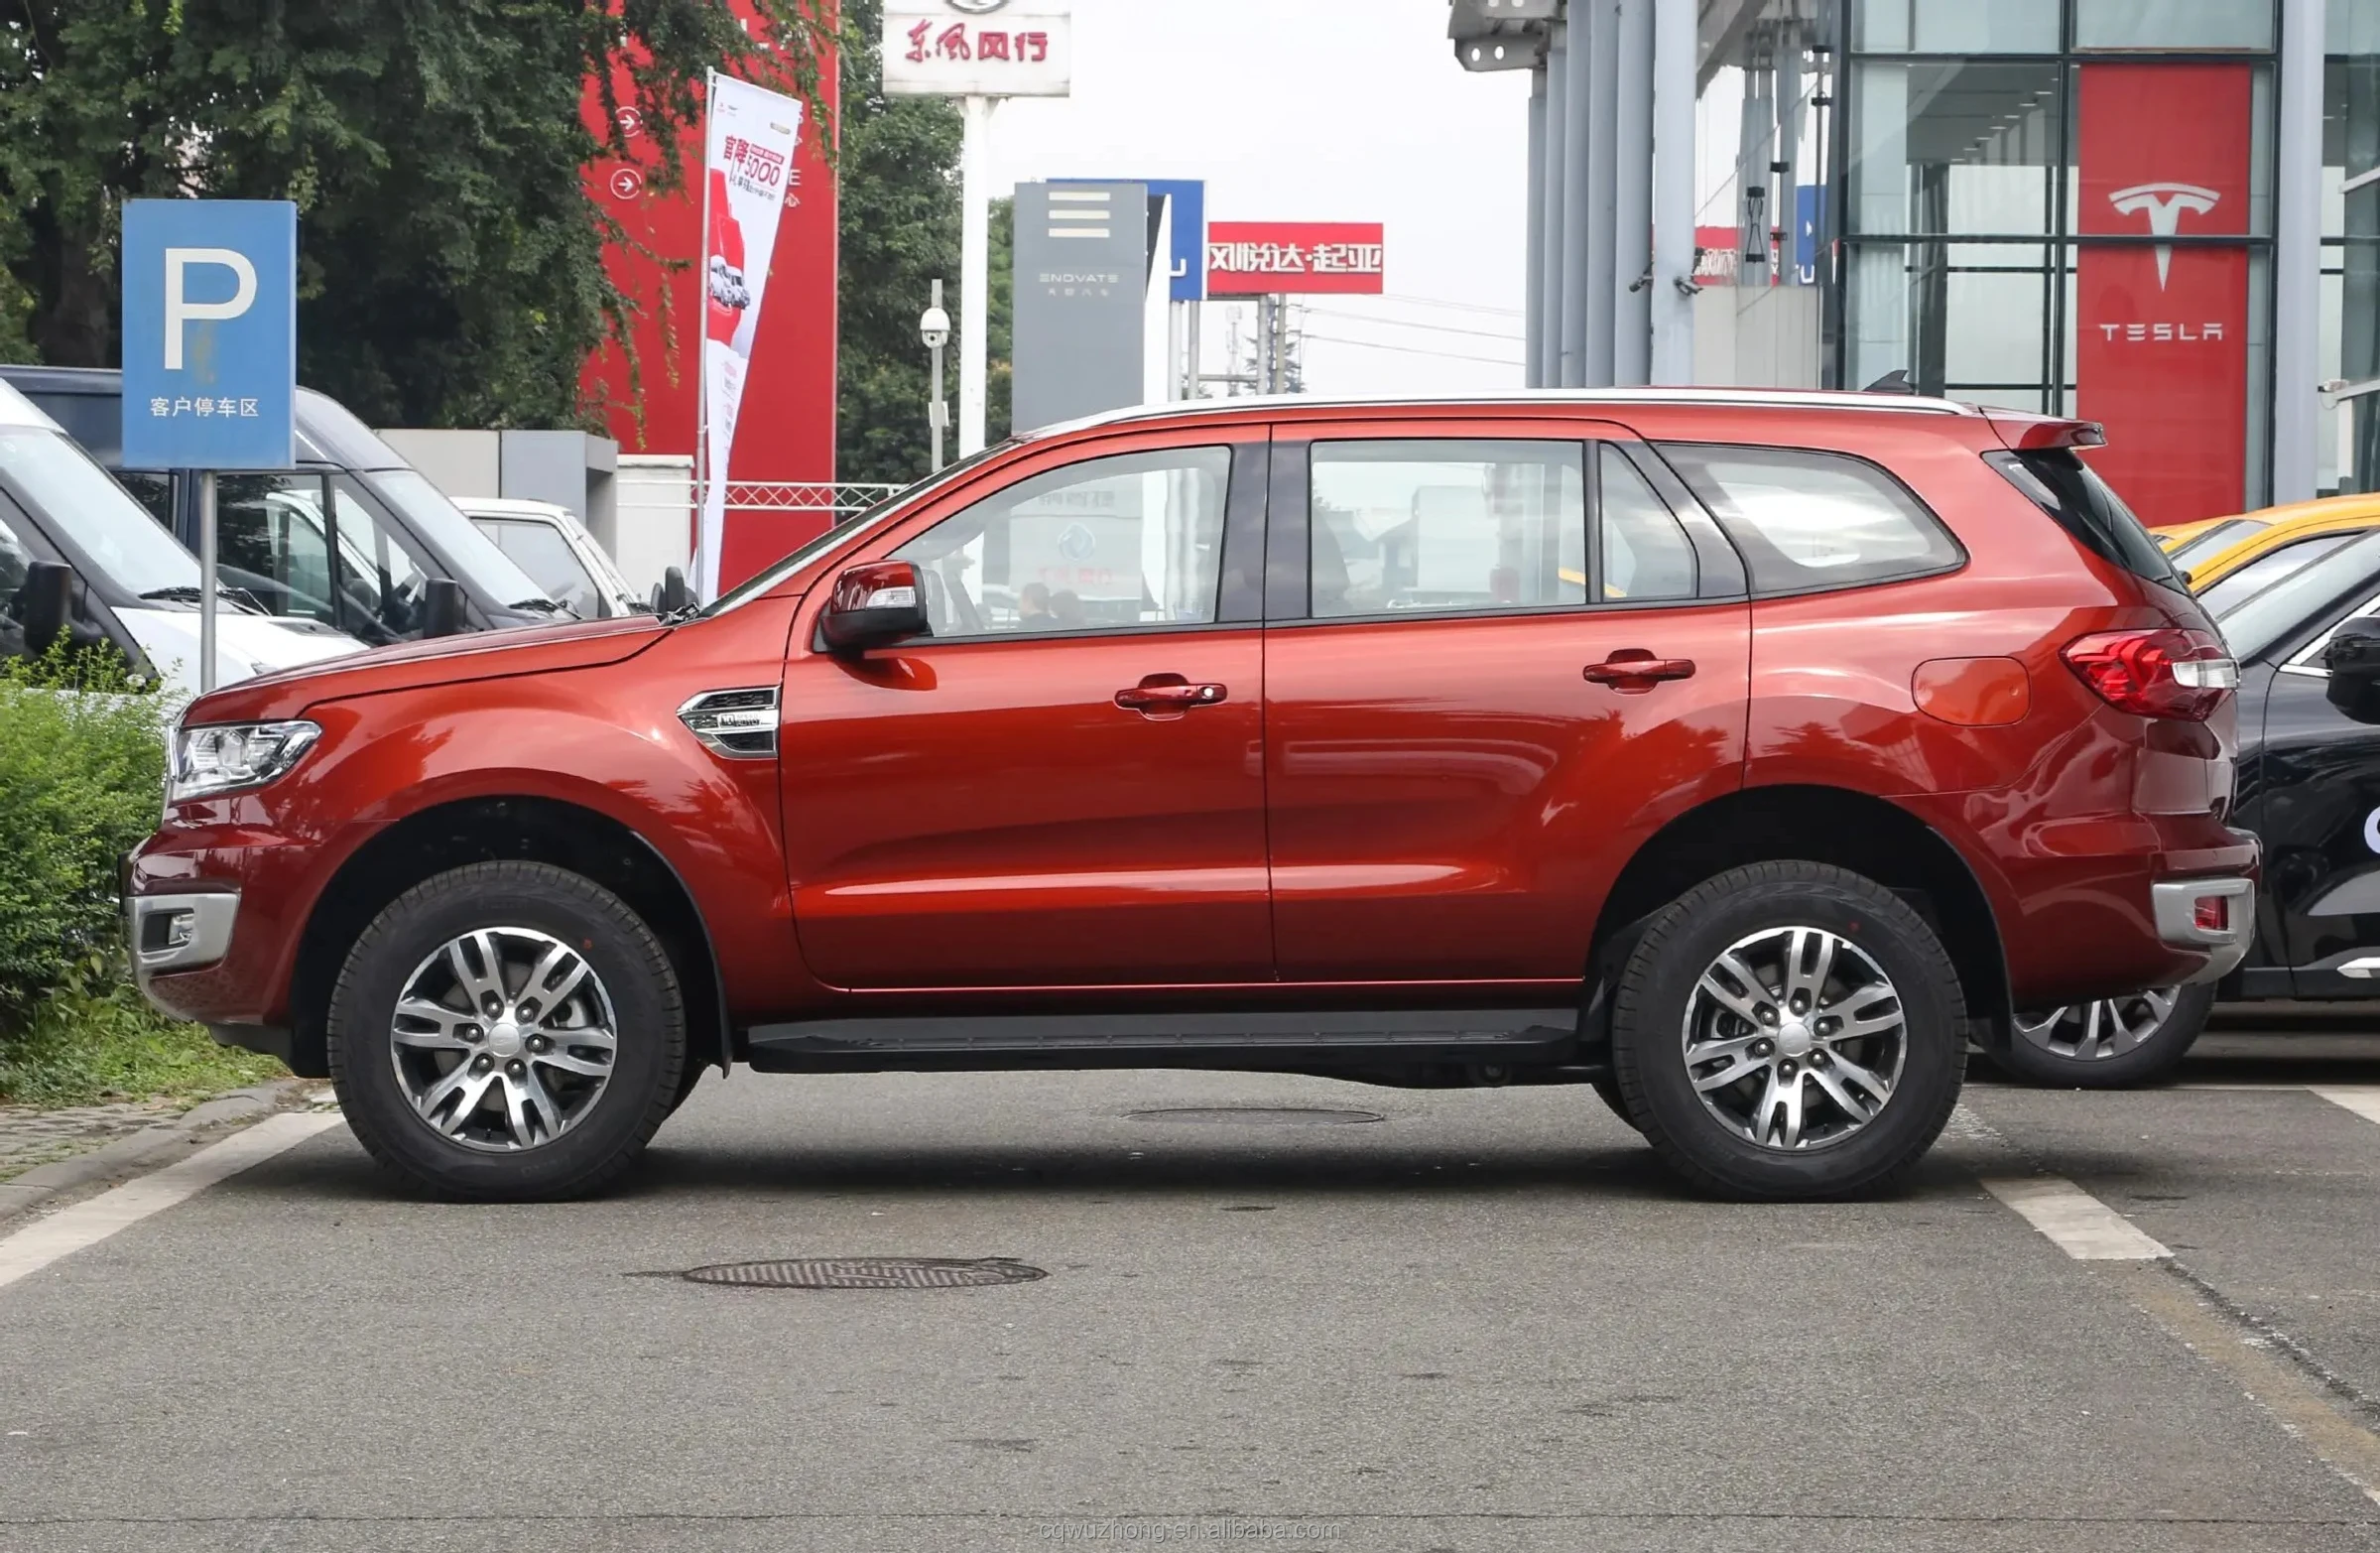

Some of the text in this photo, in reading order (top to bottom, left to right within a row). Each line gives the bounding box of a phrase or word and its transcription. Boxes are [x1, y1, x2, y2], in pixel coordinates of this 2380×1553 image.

[1039, 273, 1120, 284] ENOVATE
[165, 248, 258, 370] P
[2099, 323, 2223, 341] TESLA
[151, 397, 259, 418] 客户停车区
